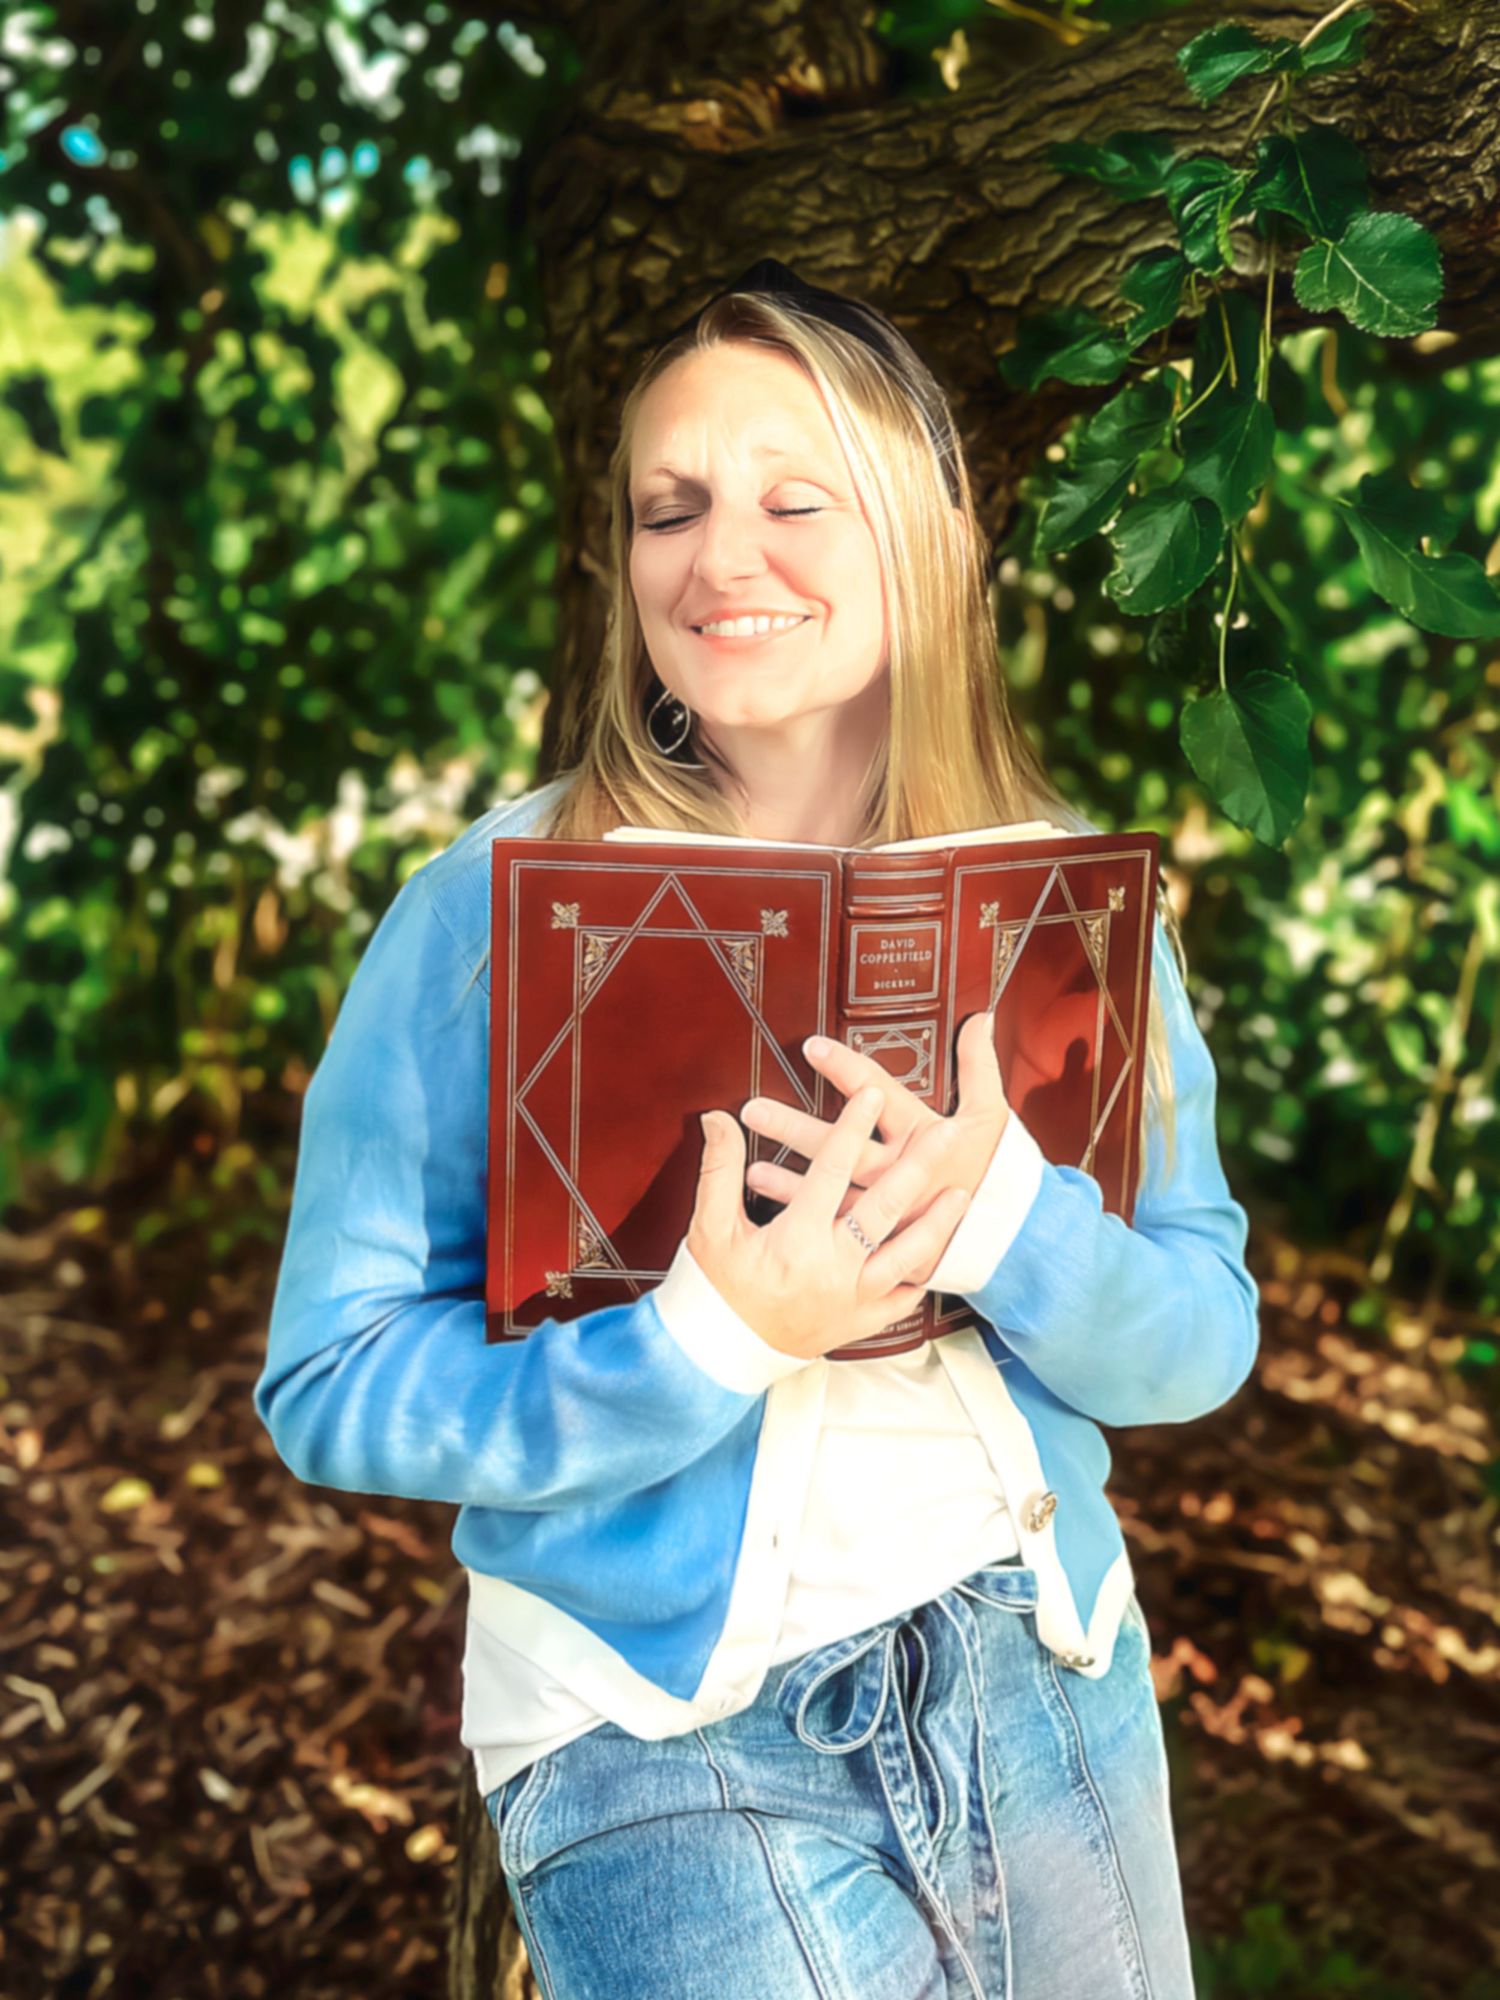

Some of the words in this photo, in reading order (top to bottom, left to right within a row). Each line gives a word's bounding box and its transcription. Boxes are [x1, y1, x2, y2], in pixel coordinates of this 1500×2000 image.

[880, 938, 915, 949] DAVID
[860, 950, 932, 964] COPPERFIELD
[874, 979, 916, 990] DICKENS
